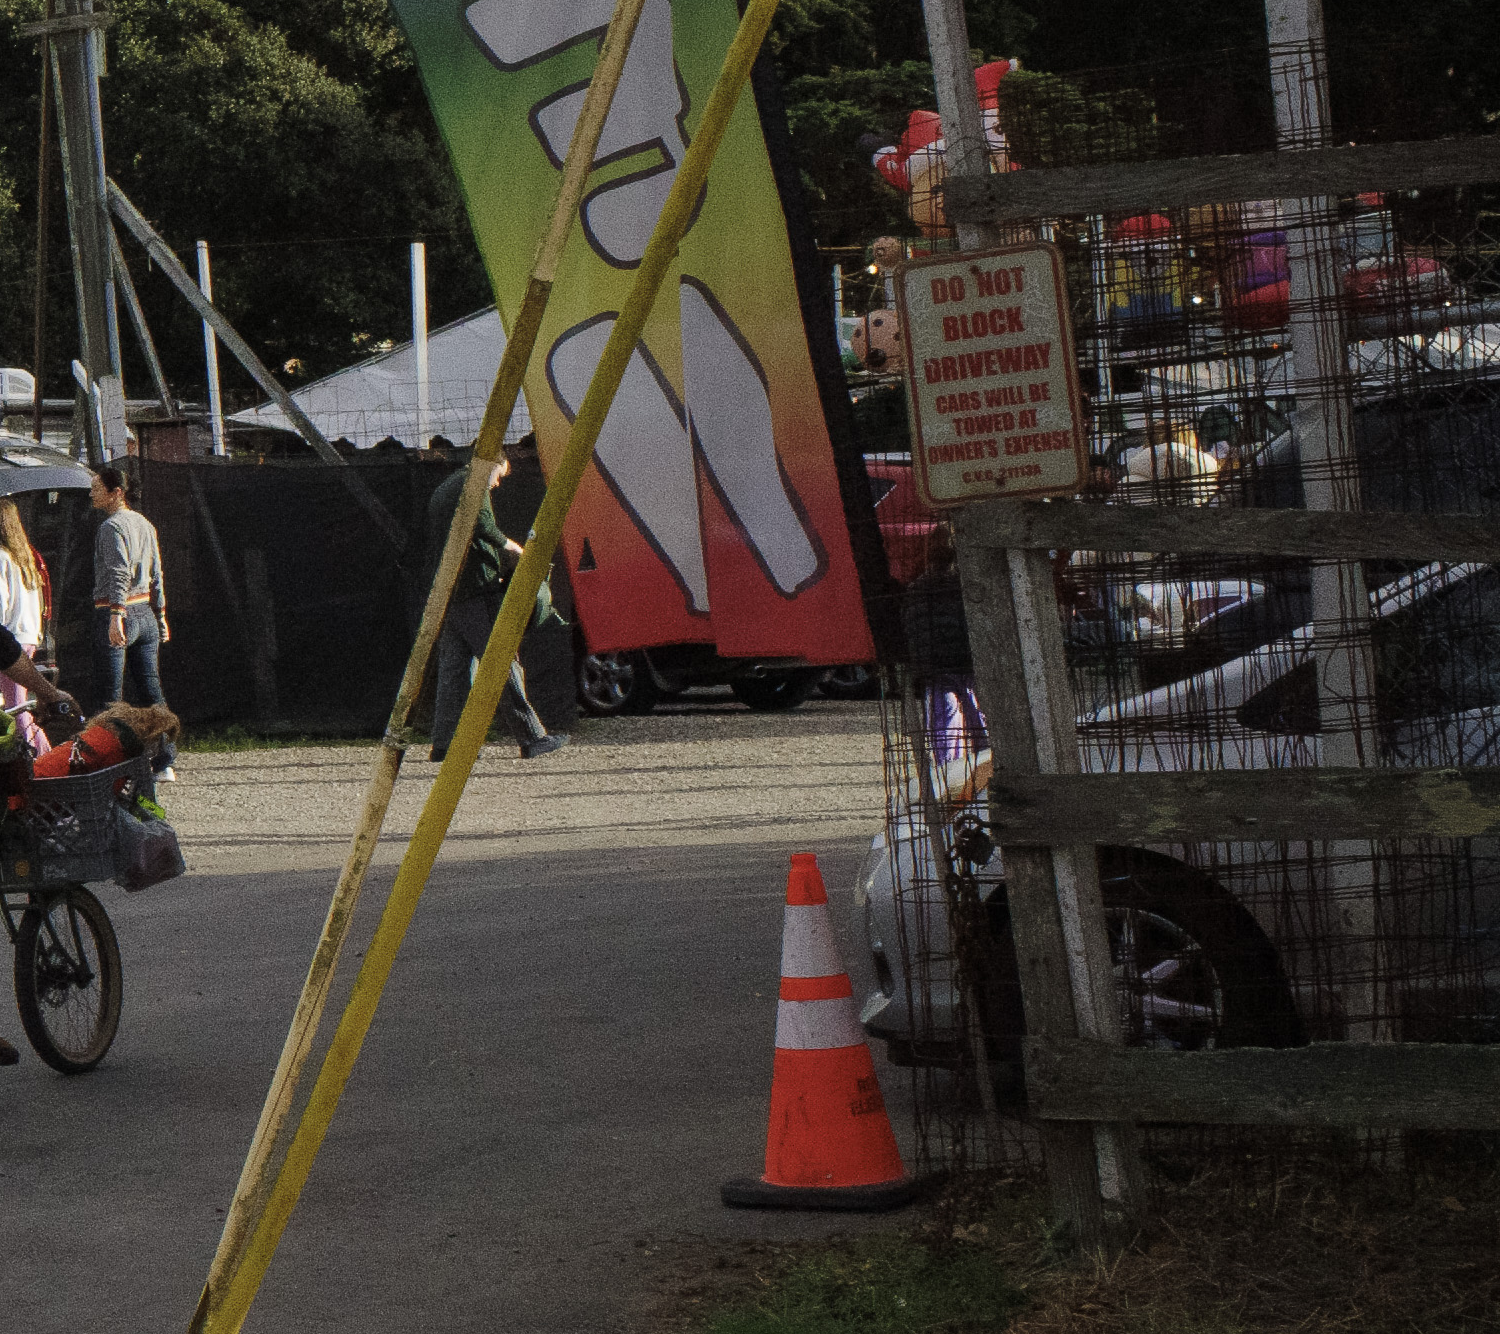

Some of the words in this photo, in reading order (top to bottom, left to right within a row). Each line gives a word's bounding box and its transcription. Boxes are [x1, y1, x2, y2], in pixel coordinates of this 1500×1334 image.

[931, 275, 966, 304] DO
[977, 267, 1025, 298] NOT
[942, 306, 1025, 342] BLOCK
[924, 342, 1052, 385] DRIVEWAY
[935, 390, 982, 414] CARS
[984, 385, 1026, 408] WILL
[1029, 382, 1051, 403] BE
[953, 412, 1016, 437] TOWED
[1018, 408, 1038, 429] AT
[928, 439, 999, 465] OWNER'S
[1004, 430, 1072, 456] EXPENSE
